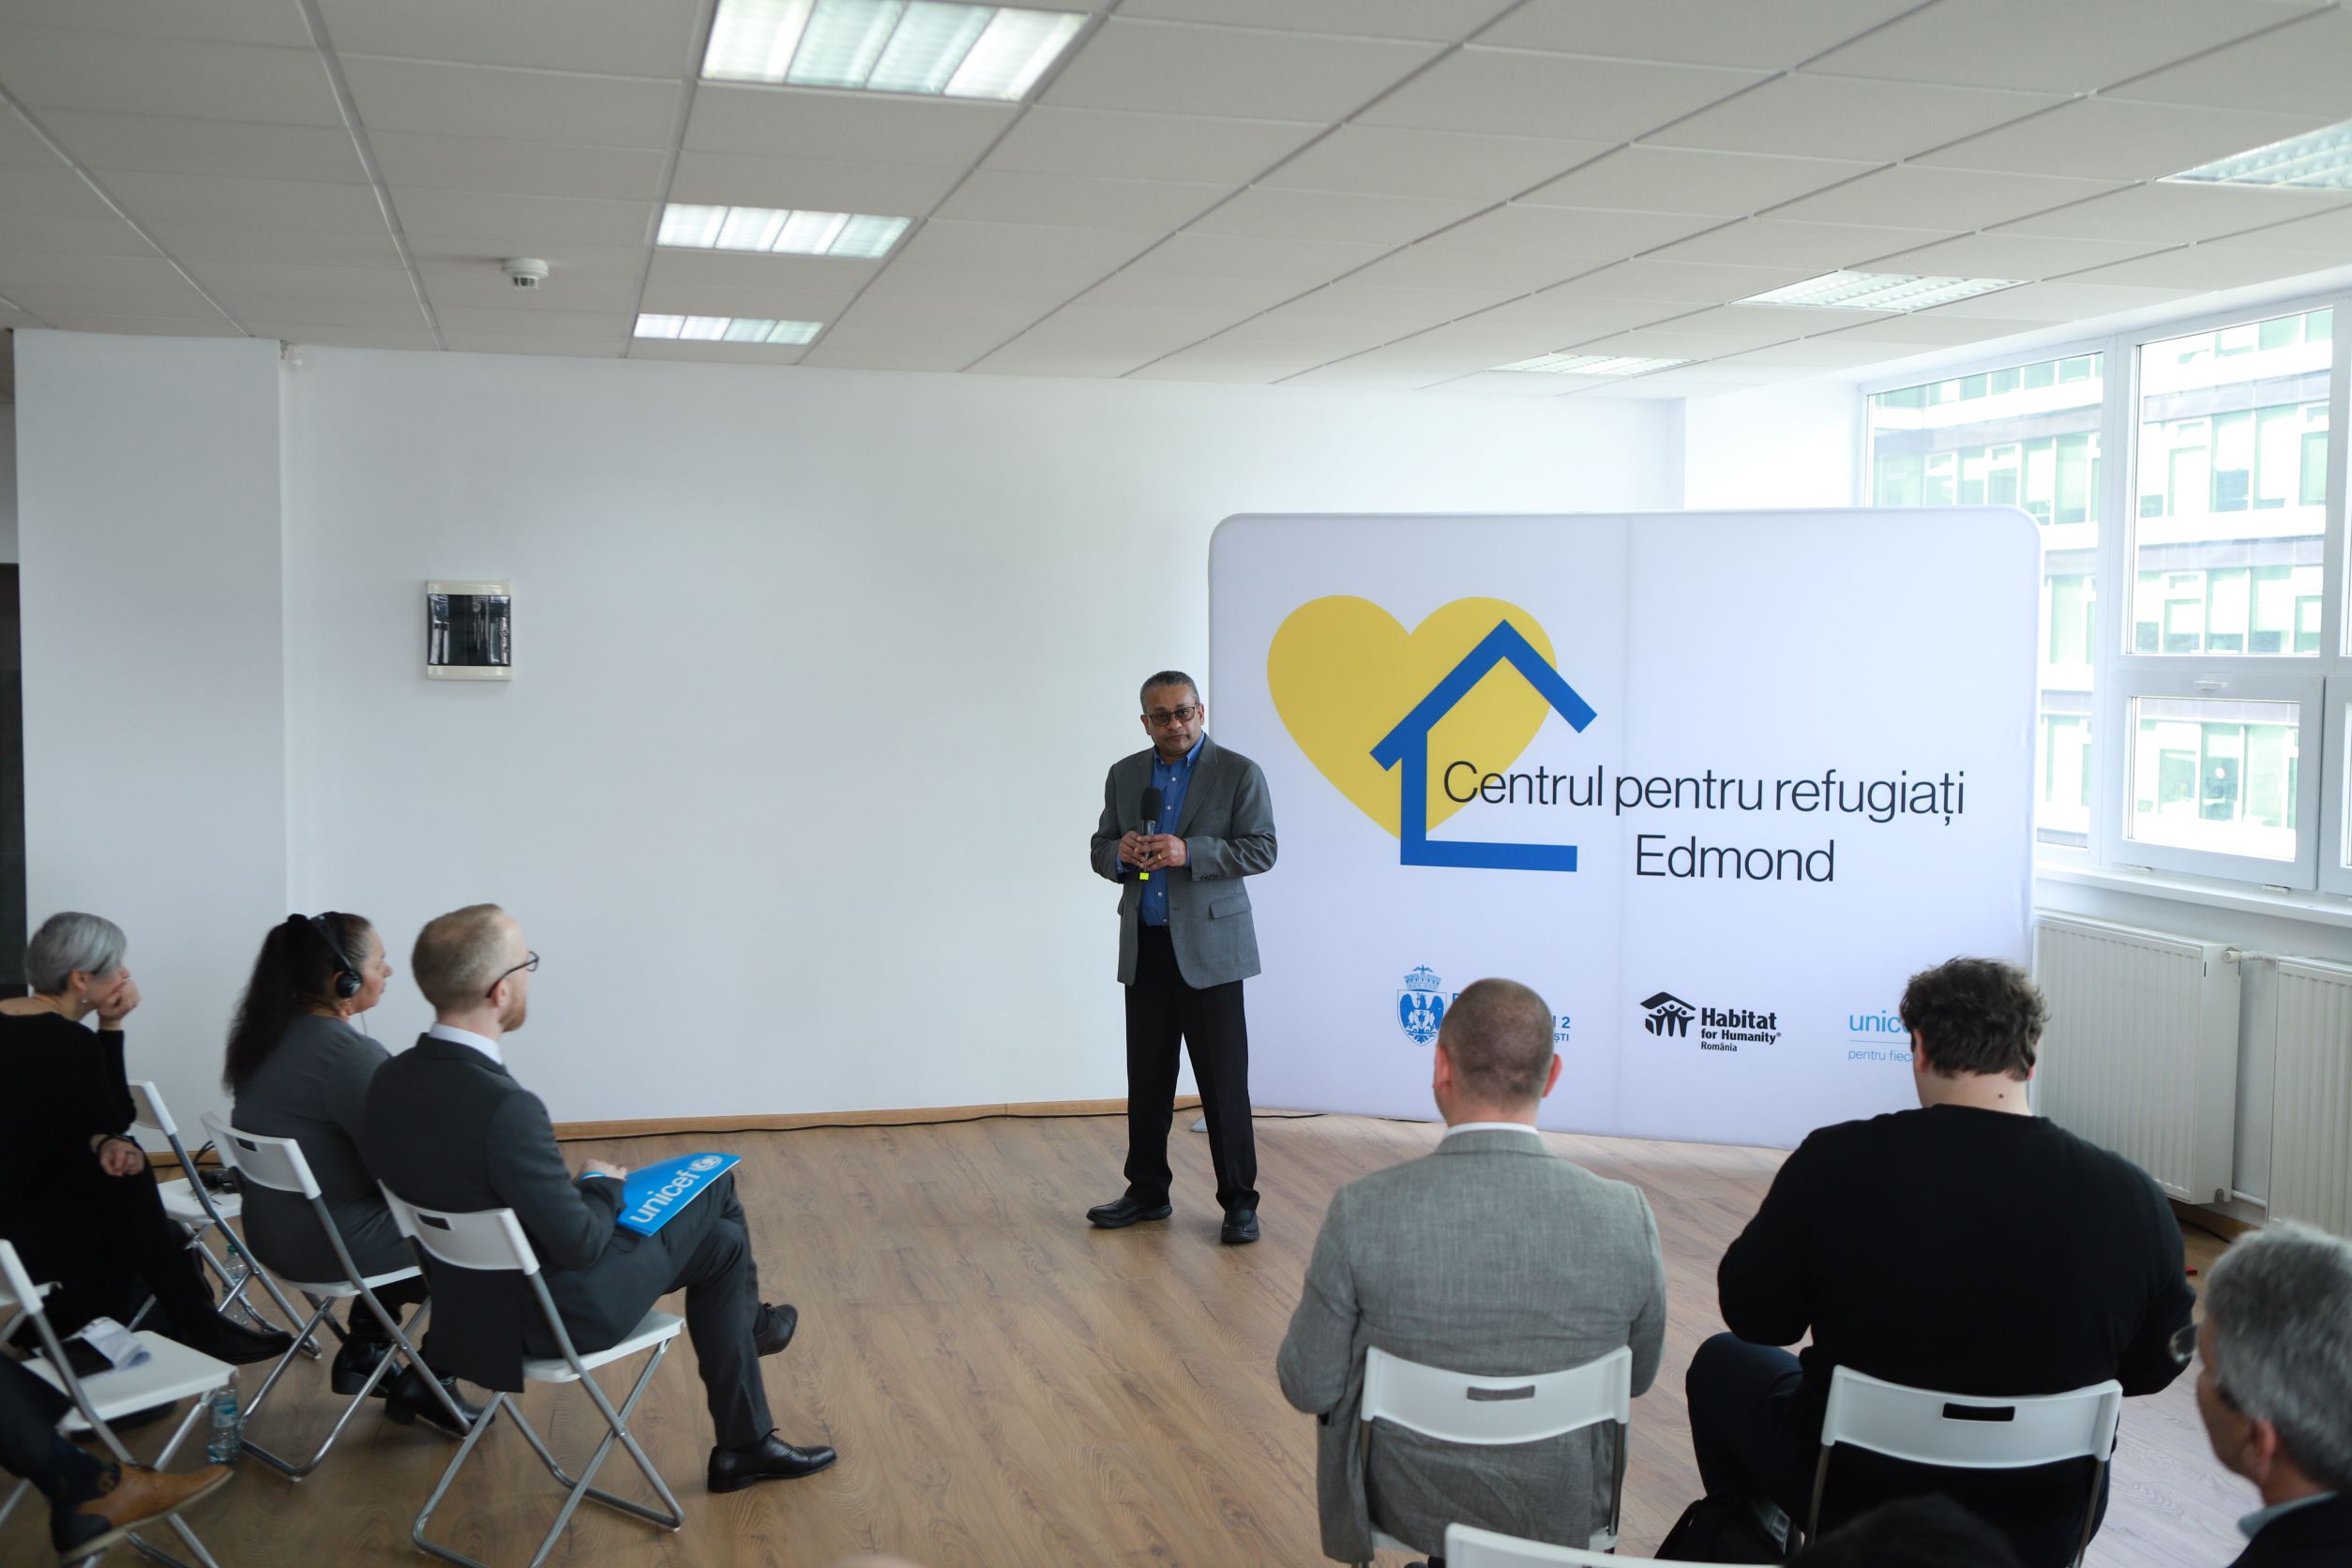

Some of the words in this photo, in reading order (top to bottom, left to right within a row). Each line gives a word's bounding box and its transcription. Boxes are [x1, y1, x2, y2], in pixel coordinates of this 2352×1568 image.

[1443, 761, 1603, 807] Centrul
[1615, 769, 1763, 816] pentru
[1775, 768, 1965, 826] refugiați
[1636, 834, 1834, 882] Edmond
[1560, 1016, 1571, 1029] 2
[1701, 1007, 1777, 1031] Habitat
[1848, 1009, 1911, 1033] unic
[1700, 1028, 1718, 1040] for
[1700, 1041, 1738, 1052] România
[1847, 1049, 1886, 1062] pentru
[1890, 1049, 1914, 1063] fiec
[629, 1169, 701, 1223] unicef
